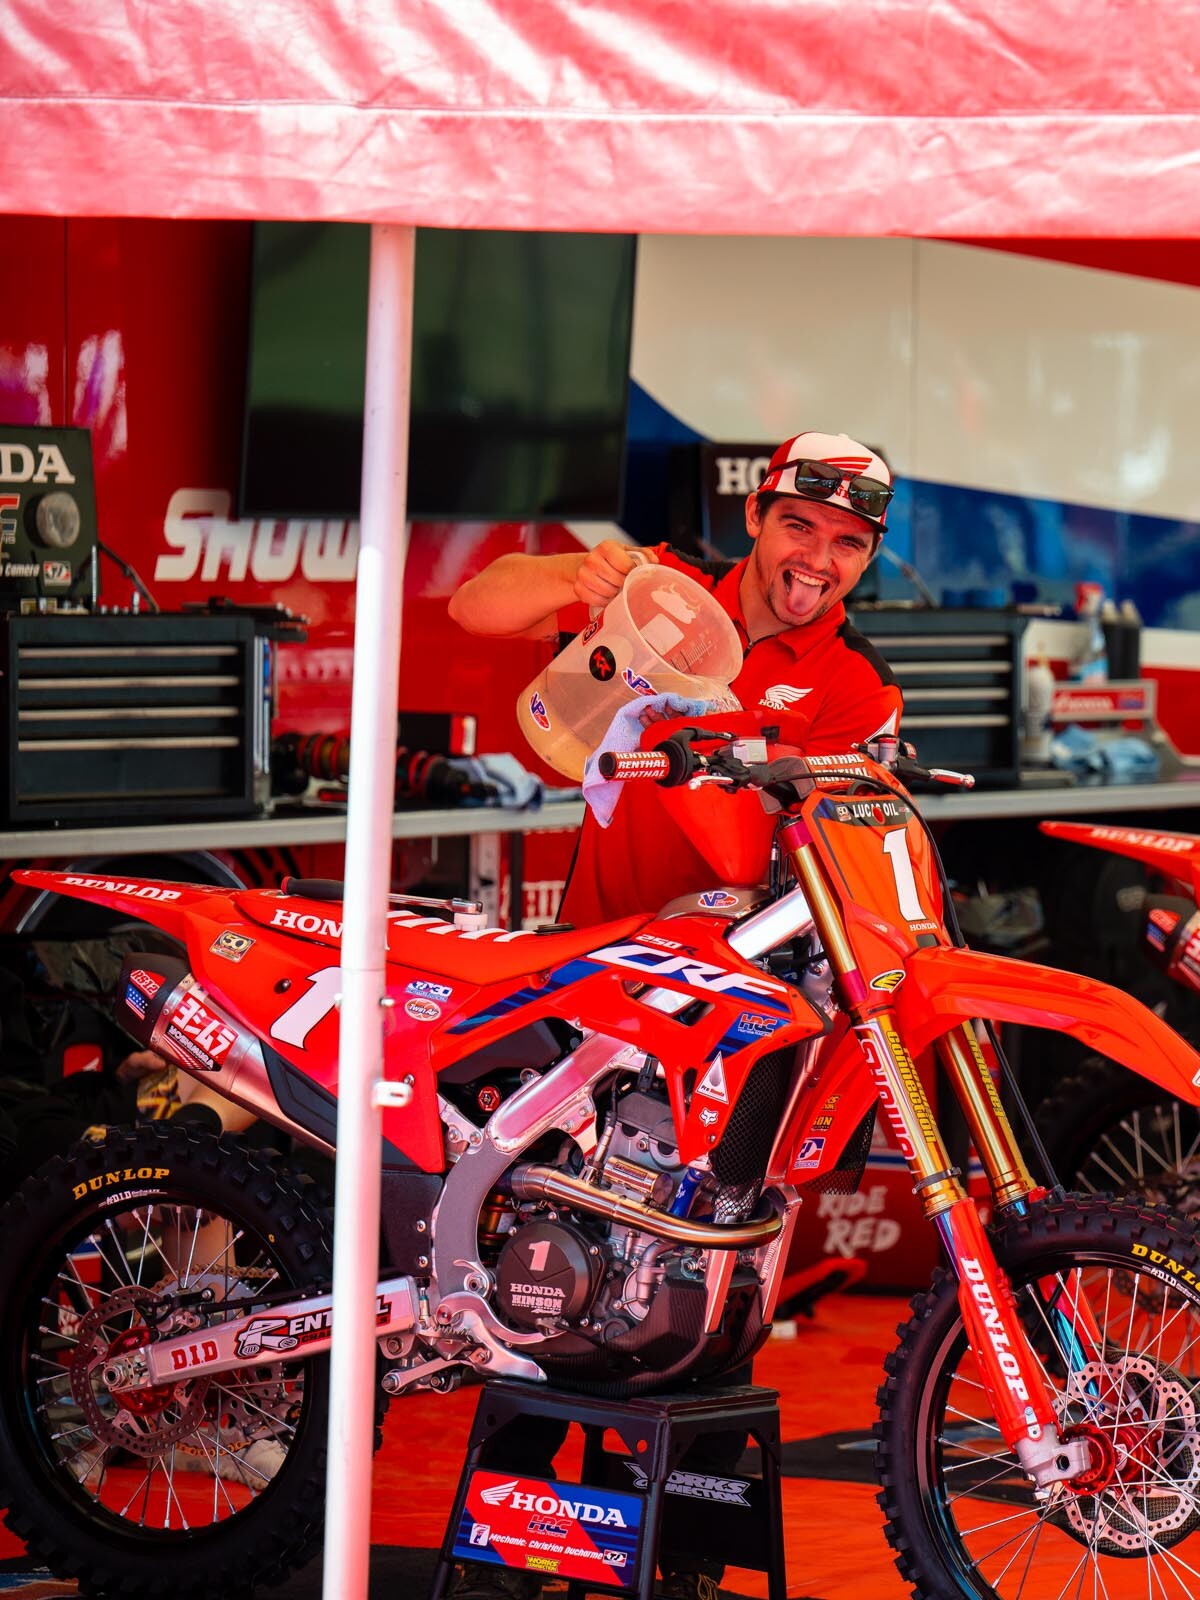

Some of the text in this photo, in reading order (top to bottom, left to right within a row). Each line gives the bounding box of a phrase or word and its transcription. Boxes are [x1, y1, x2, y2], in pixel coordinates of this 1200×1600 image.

[618, 759, 668, 769] RENTHAL
[805, 754, 865, 766] RENTHAL
[616, 770, 665, 779] RENTHAL
[883, 803, 899, 817] OIL
[1091, 828, 1196, 854] DUNLOP
[883, 827, 927, 922] 1
[64, 876, 182, 901] DUNLOP
[702, 892, 728, 906] VP
[269, 908, 345, 939] HON
[909, 922, 938, 932] HONDA
[586, 944, 788, 995] CRF
[270, 965, 345, 1051] 1
[409, 1003, 438, 1016] Twin Air
[172, 997, 235, 1057] ヨシムラ
[738, 1013, 777, 1033] HRC
[167, 1024, 215, 1069] YOSHIMURA
[72, 1167, 170, 1200] DUNLOP
[817, 1185, 888, 1219] RIDE
[824, 1217, 902, 1259] RED
[528, 1240, 551, 1271] 1
[509, 1283, 566, 1298] HONDA
[511, 1294, 563, 1308] HINSON
[960, 1256, 1029, 1401] DUNLOP
[171, 1340, 219, 1370] D.I.D
[510, 1491, 627, 1528] HONDA
[526, 1515, 573, 1535] HRC
[489, 1532, 526, 1548] Mechanic:
[529, 1540, 563, 1554] Christien
[565, 1546, 603, 1561] Ducharme
[526, 1556, 560, 1568] WORKS
